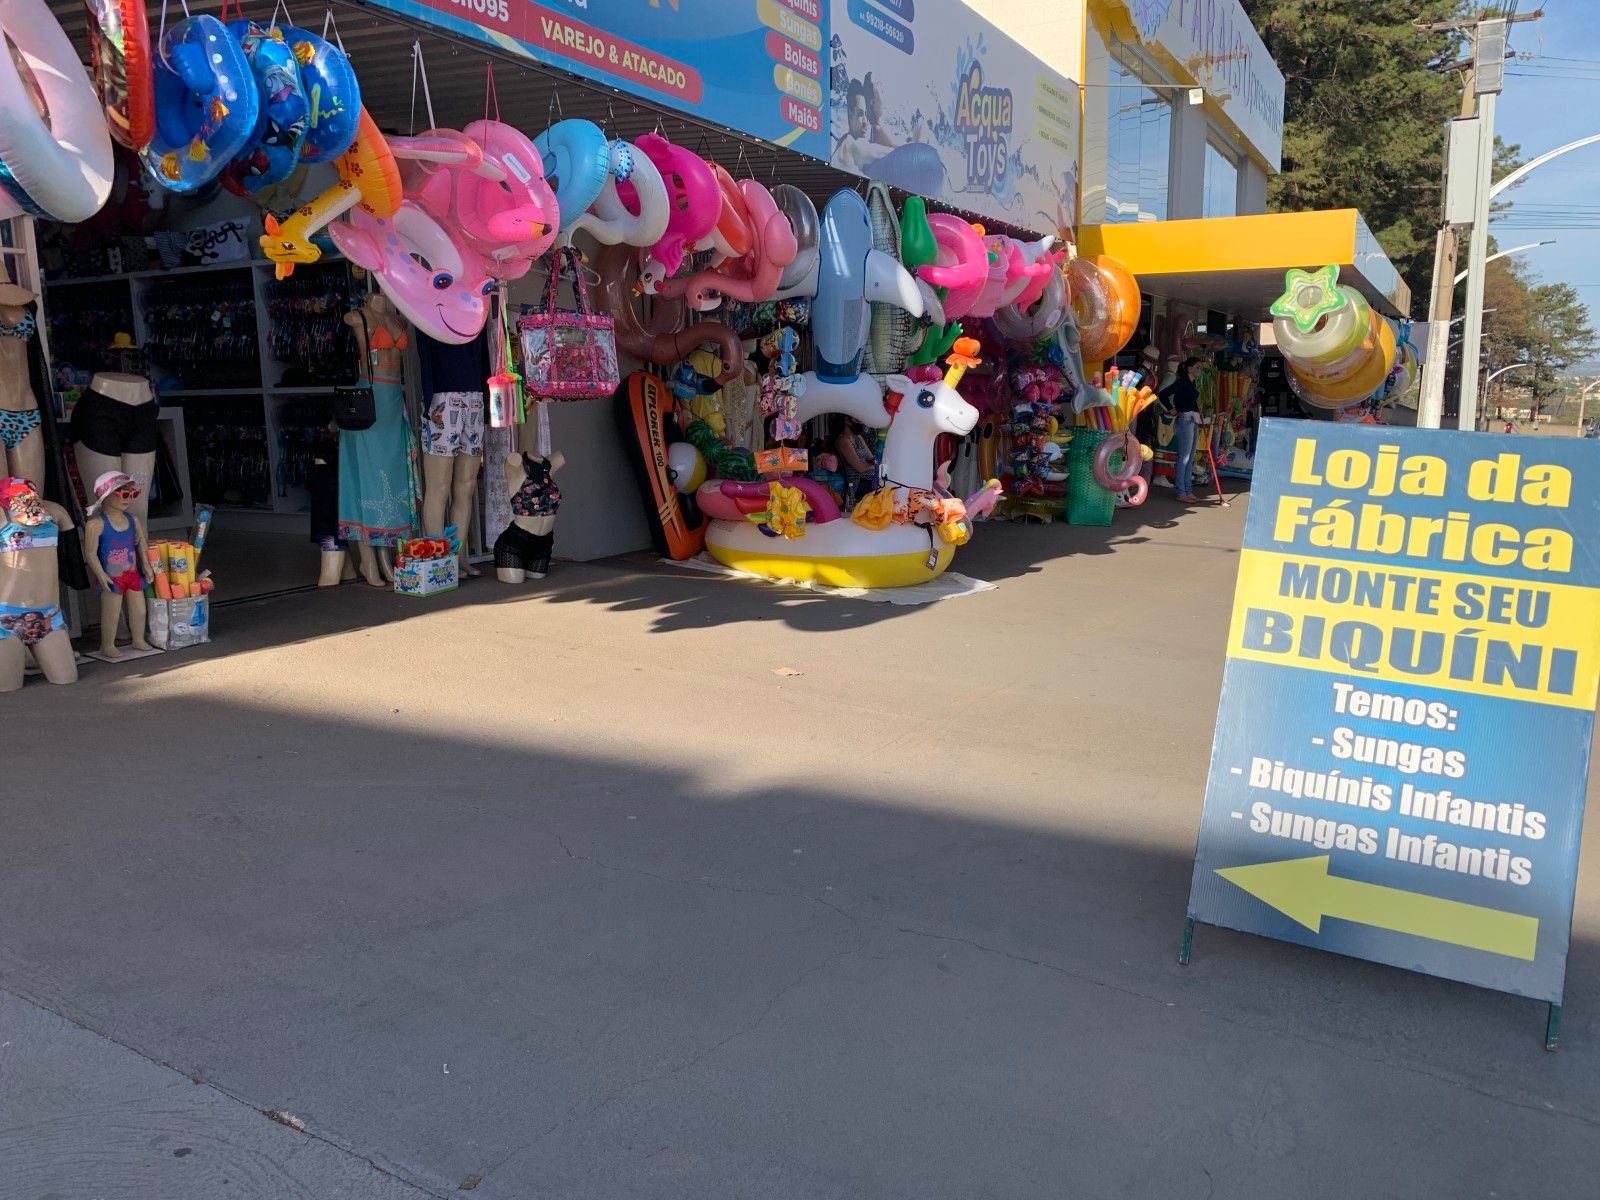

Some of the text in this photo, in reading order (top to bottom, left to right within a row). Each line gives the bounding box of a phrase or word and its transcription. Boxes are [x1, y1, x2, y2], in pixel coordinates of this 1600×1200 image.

[541, 16, 686, 90] VAREJO & ATACADO
[780, 9, 817, 43] Sungas
[784, 42, 818, 75] Bolsas
[786, 72, 817, 100] Bonés
[788, 102, 818, 130] Maiôs
[955, 78, 1012, 138] Acqua
[966, 132, 1007, 188] Toys
[647, 383, 665, 468] EXPLORER 100
[1290, 437, 1572, 508] Loja da
[1273, 495, 1573, 573] Fábrica
[1278, 562, 1551, 629] MONTE SEU
[1241, 607, 1578, 696] BIQUÍNI
[1332, 682, 1458, 731] Temos:
[1331, 727, 1466, 778] Sungas
[1248, 758, 1393, 811] Biquínis
[1400, 783, 1547, 840] Infantis
[1249, 801, 1378, 855] Sungas
[1385, 827, 1533, 886] Infantis
